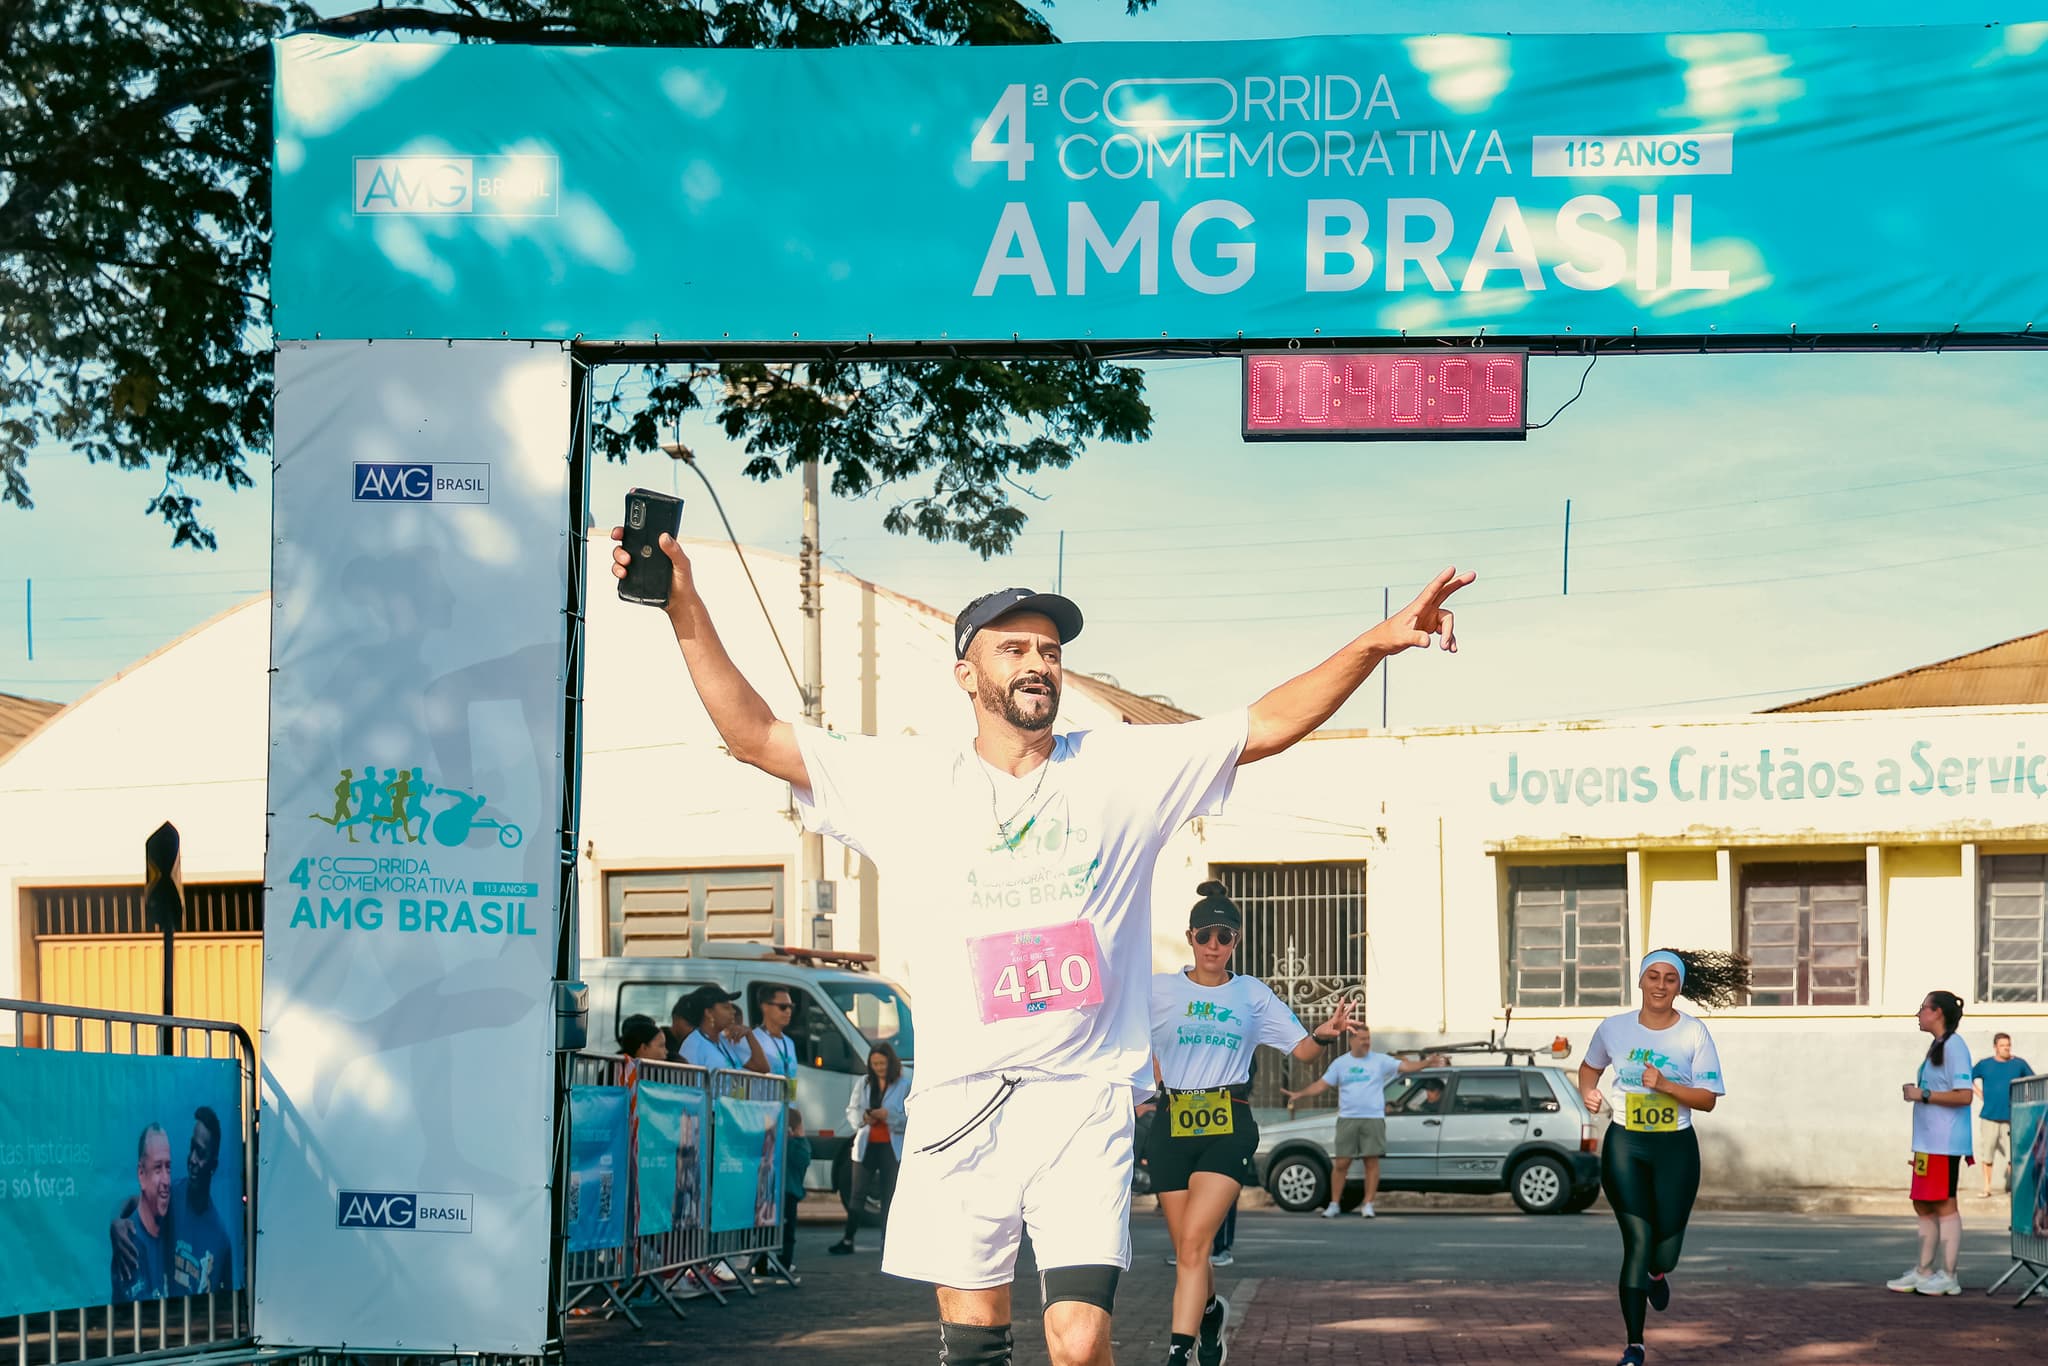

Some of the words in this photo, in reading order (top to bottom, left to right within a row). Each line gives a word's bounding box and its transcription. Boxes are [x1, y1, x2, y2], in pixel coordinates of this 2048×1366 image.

[1060, 73, 1401, 127] CORRIDA
[1059, 129, 1512, 180] COMEMORATIVA
[1563, 141, 1606, 168] 113
[1614, 139, 1701, 168] ANOS
[362, 164, 467, 208] AMG
[478, 178, 550, 197] BRIL
[972, 200, 1257, 297] AMG
[1305, 193, 1730, 293] BRASIL
[1252, 359, 1517, 424] 00:40:55
[358, 467, 430, 498] AMG
[436, 478, 485, 491] BRASIL
[1489, 751, 1659, 807] Jovens
[1668, 745, 1865, 801] Cristãos
[1874, 758, 1901, 795] a
[318, 856, 431, 875] CORRIDA
[318, 875, 468, 895] COMEMORATIVA
[483, 885, 498, 894] 113
[500, 885, 528, 895] ANOS
[288, 896, 384, 932] AMG
[398, 899, 538, 936] BRASIL
[992, 954, 1092, 1003] 410
[1179, 1107, 1229, 1129] 006
[1632, 1108, 1675, 1125] 108
[342, 1195, 414, 1226] AMG
[419, 1207, 468, 1221] BRASIL
